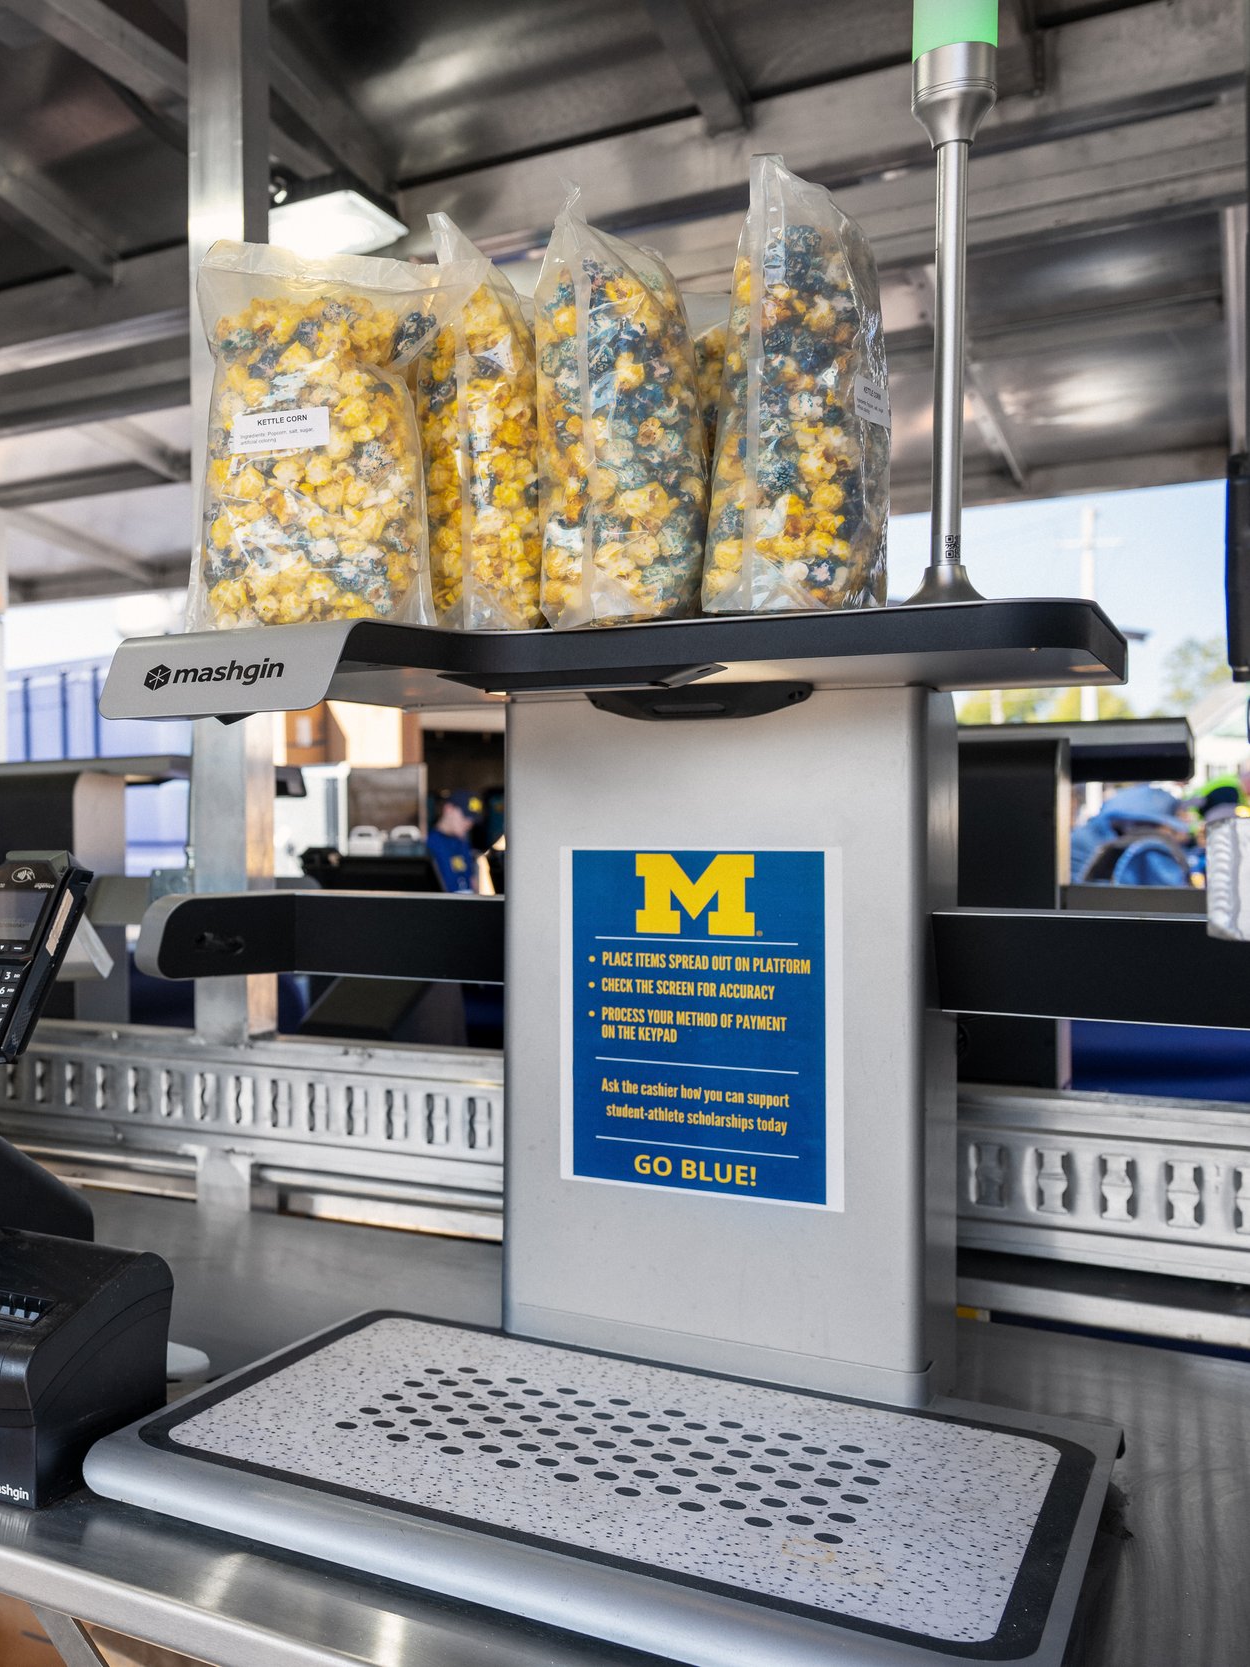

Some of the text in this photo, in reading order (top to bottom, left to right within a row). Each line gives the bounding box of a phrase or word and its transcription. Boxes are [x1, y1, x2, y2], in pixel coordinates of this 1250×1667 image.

[257, 414, 308, 426] KETTLE CORN
[173, 658, 284, 686] mashgin
[635, 853, 755, 937] M
[602, 952, 810, 974] PLACE ITEMS SPREAD OUT ON PLATFORM
[5, 971, 11, 980] 3
[0, 986, 5, 994] 6
[602, 978, 775, 1000] CHECK THE SCREEN FOR ACCURACY
[602, 1007, 787, 1032] PROCESS YOUR METHOD OF PAYMENT
[602, 1024, 677, 1043] ON THE KEYPAD
[601, 1077, 790, 1109] Ask the cashier how you can support
[606, 1103, 788, 1136] student-athlete scholarships today
[634, 1154, 757, 1187] GO BLUE!
